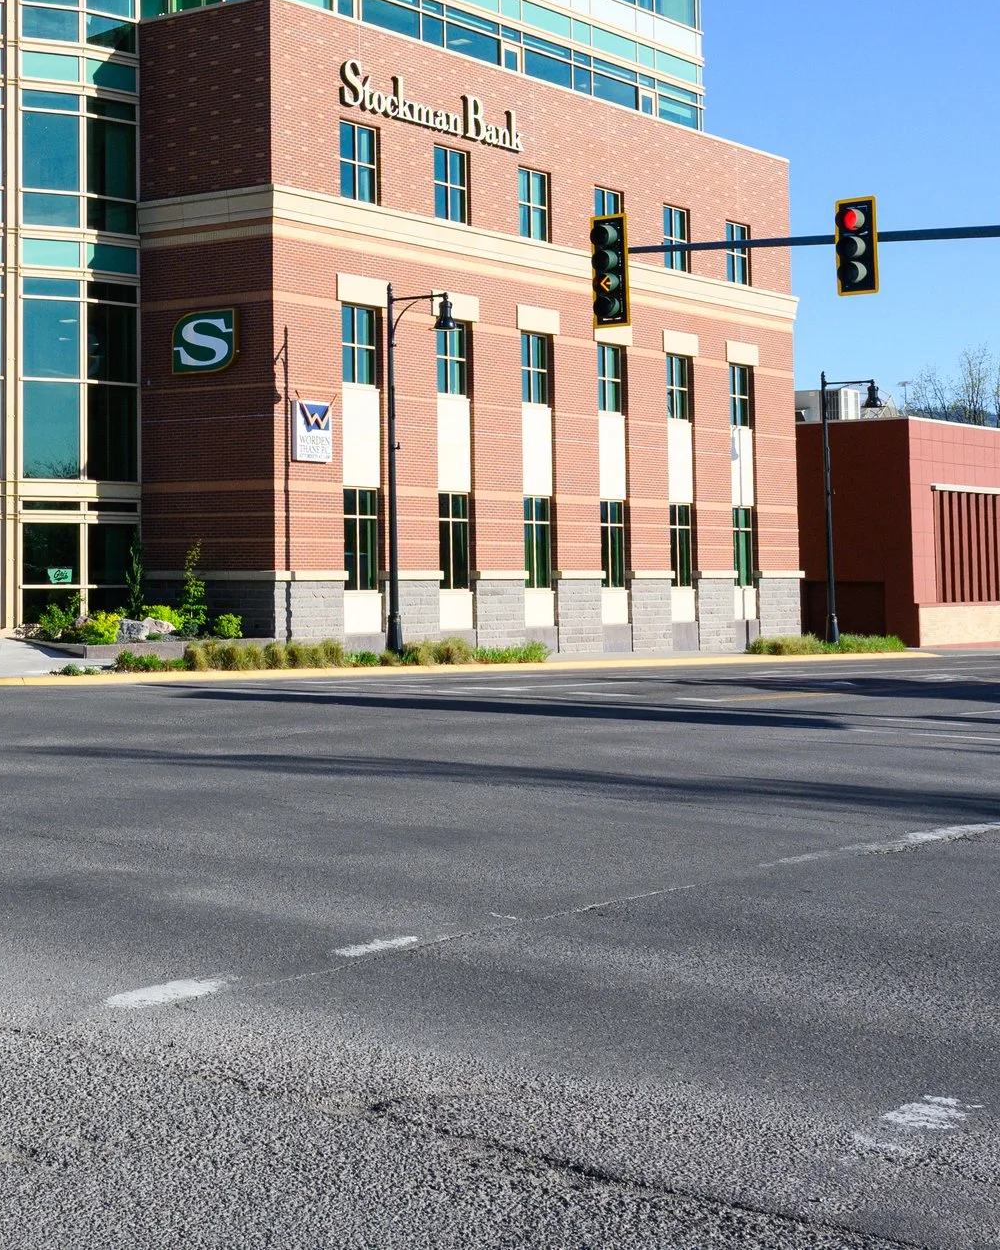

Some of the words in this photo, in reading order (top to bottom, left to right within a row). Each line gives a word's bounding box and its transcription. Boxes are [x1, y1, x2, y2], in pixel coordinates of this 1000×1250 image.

[341, 58, 464, 136] Stockman
[464, 93, 525, 152] Bank
[173, 318, 233, 366] S
[299, 435, 330, 446] WORDEN
